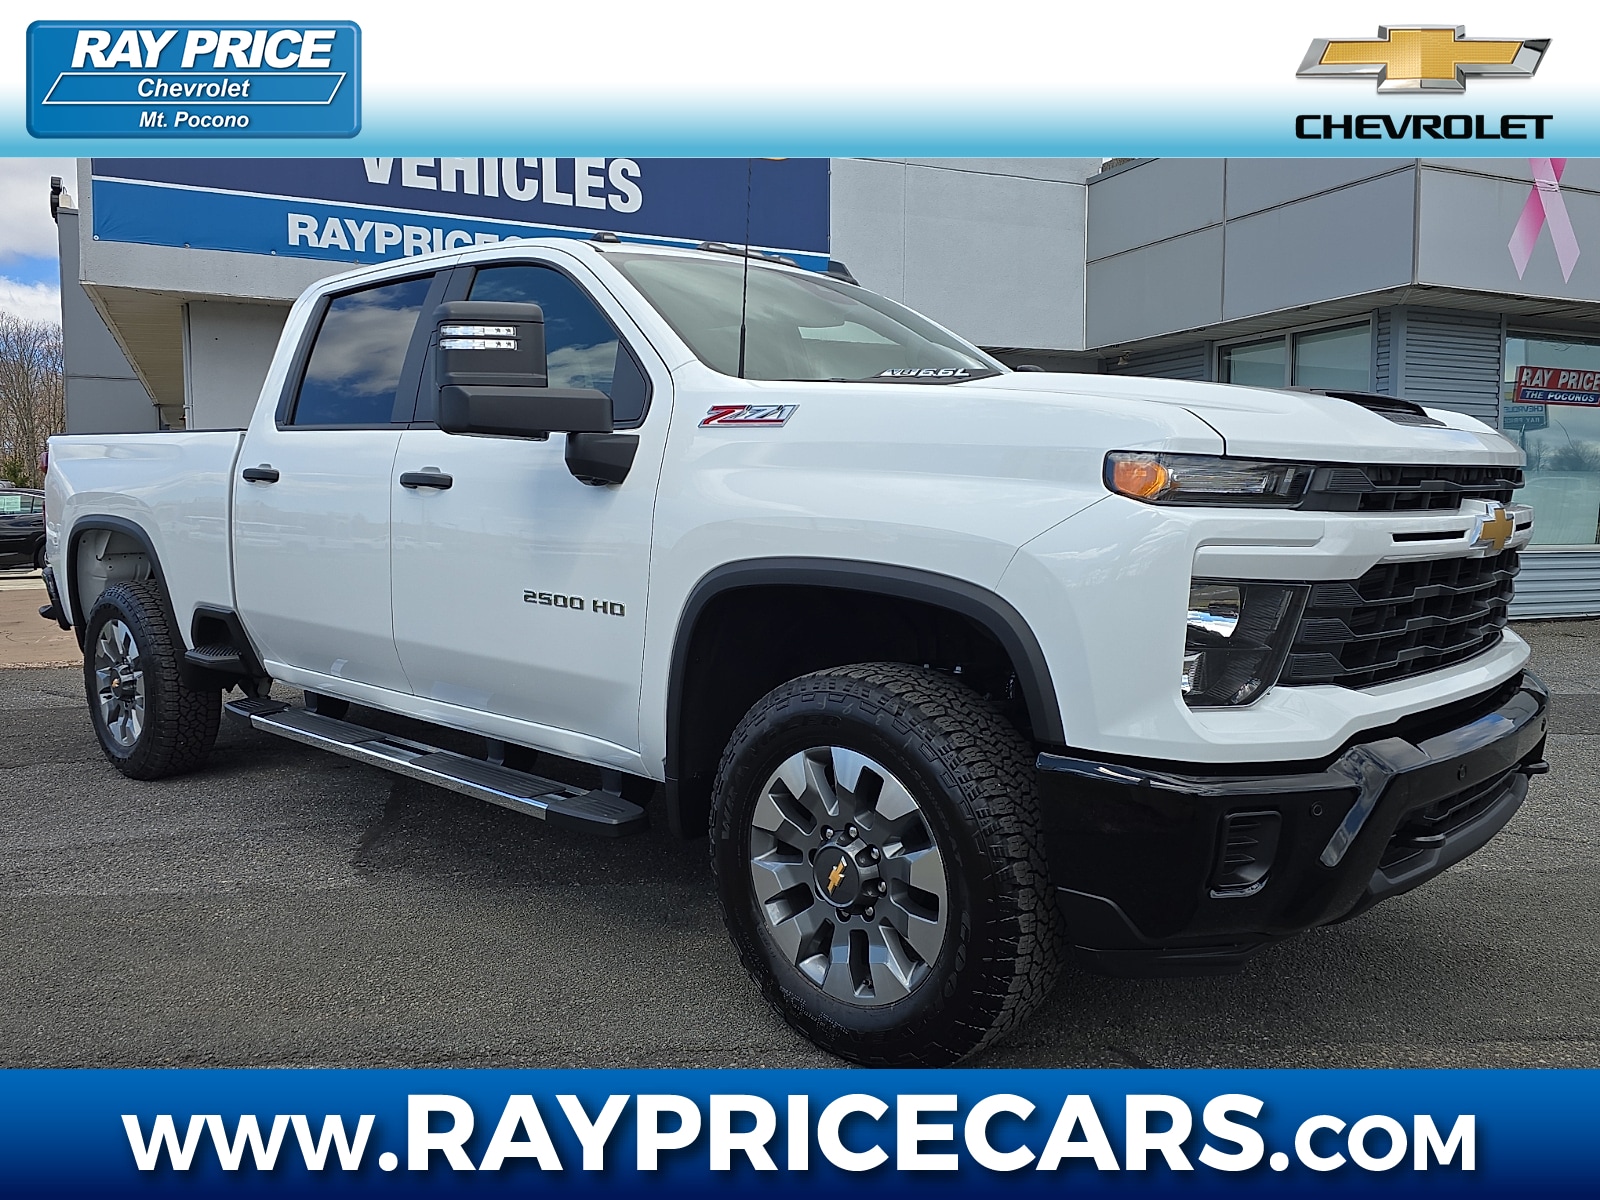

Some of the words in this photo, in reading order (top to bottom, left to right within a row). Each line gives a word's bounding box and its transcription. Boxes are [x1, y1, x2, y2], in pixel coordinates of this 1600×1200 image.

[287, 213, 526, 257] RAYPRIC
[1520, 368, 1554, 387] RAY
[1557, 371, 1600, 391] PRICE
[1525, 390, 1545, 400] THE
[1547, 391, 1595, 403] POCONOS
[697, 404, 800, 428] Z71
[523, 589, 585, 611] 2500
[592, 599, 626, 617] HD
